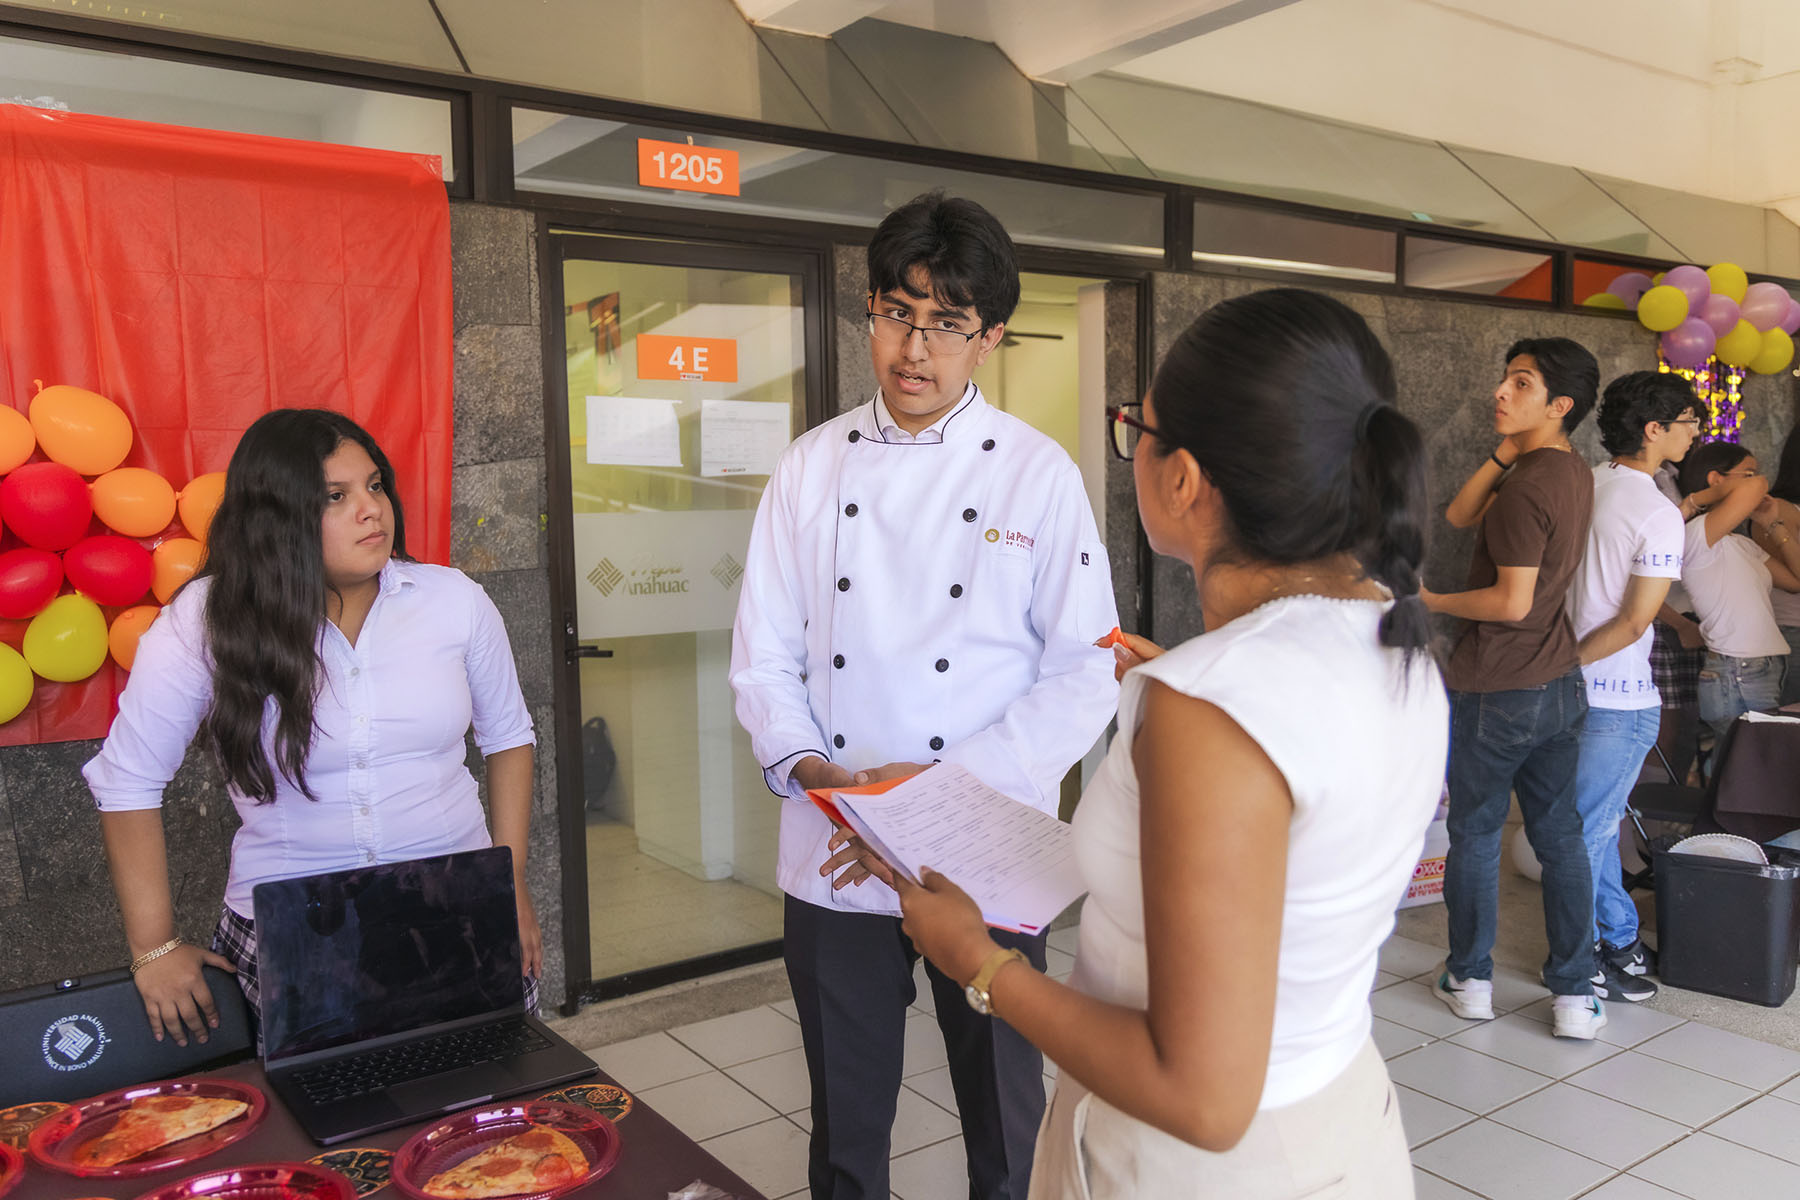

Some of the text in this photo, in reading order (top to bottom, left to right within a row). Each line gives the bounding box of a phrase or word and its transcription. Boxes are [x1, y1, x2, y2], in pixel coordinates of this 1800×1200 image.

[653, 151, 723, 184] 1205
[668, 346, 709, 372] 4 E
